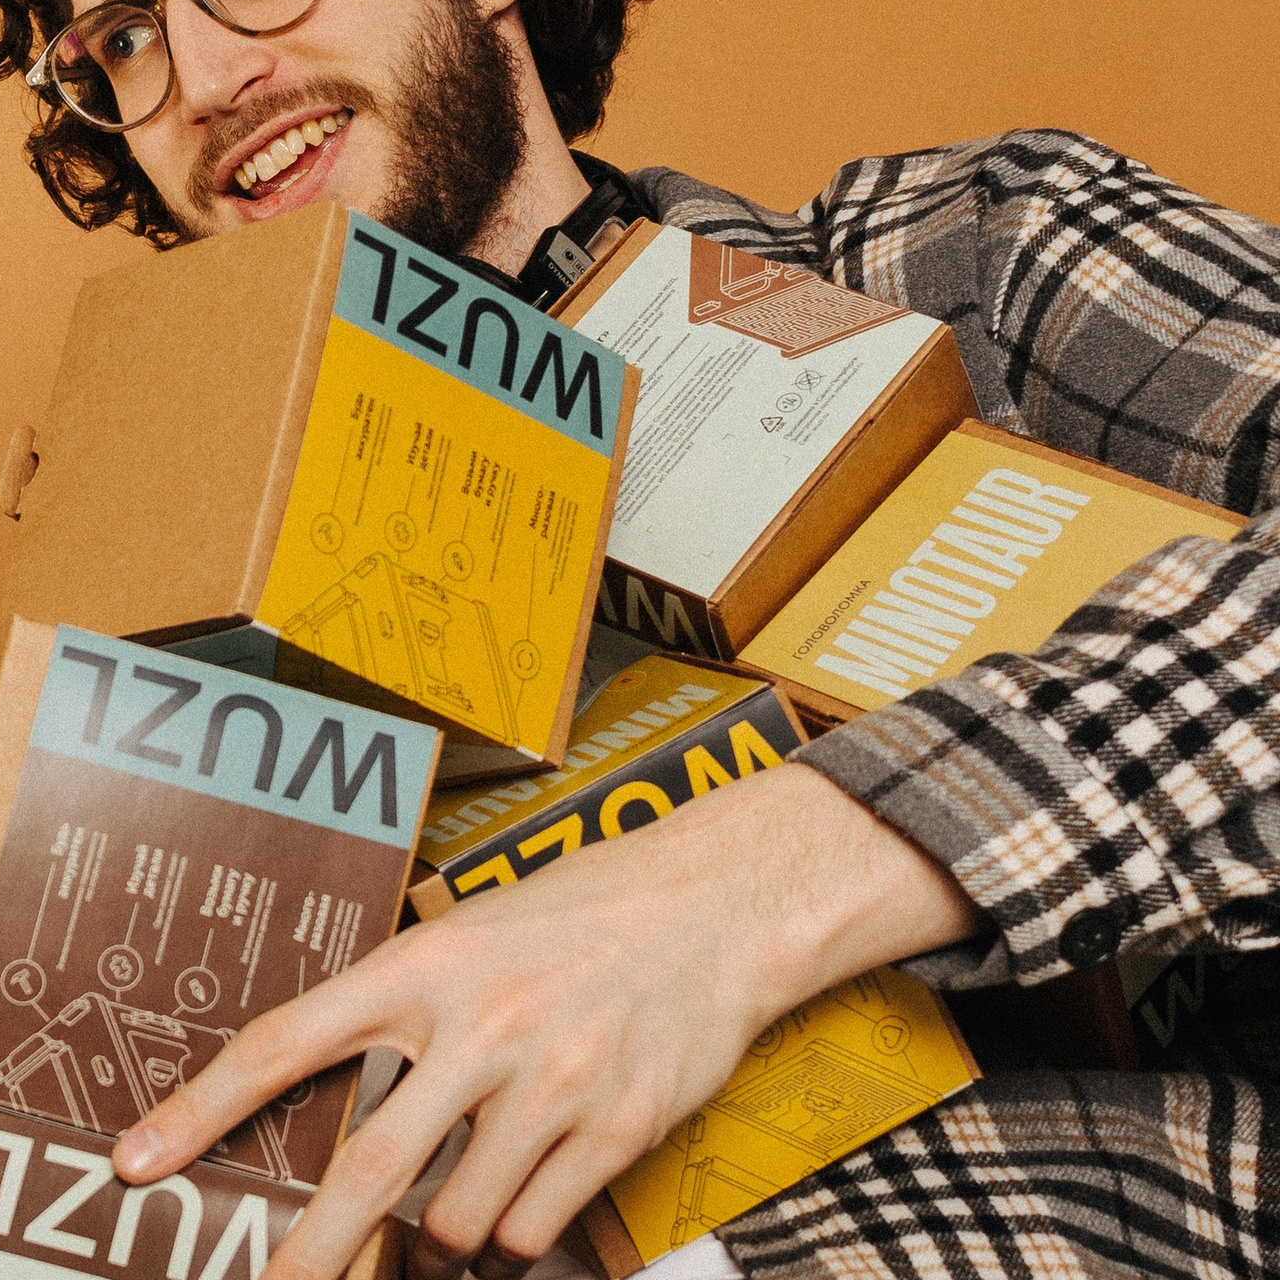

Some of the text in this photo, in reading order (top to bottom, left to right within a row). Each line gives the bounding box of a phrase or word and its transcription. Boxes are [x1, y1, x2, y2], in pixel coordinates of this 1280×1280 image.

[353, 228, 607, 441] WUZL
[792, 578, 872, 661] ГОЛОВОЛОМКА
[815, 467, 1095, 698] MINOTAUR
[61, 645, 399, 829] WUZL
